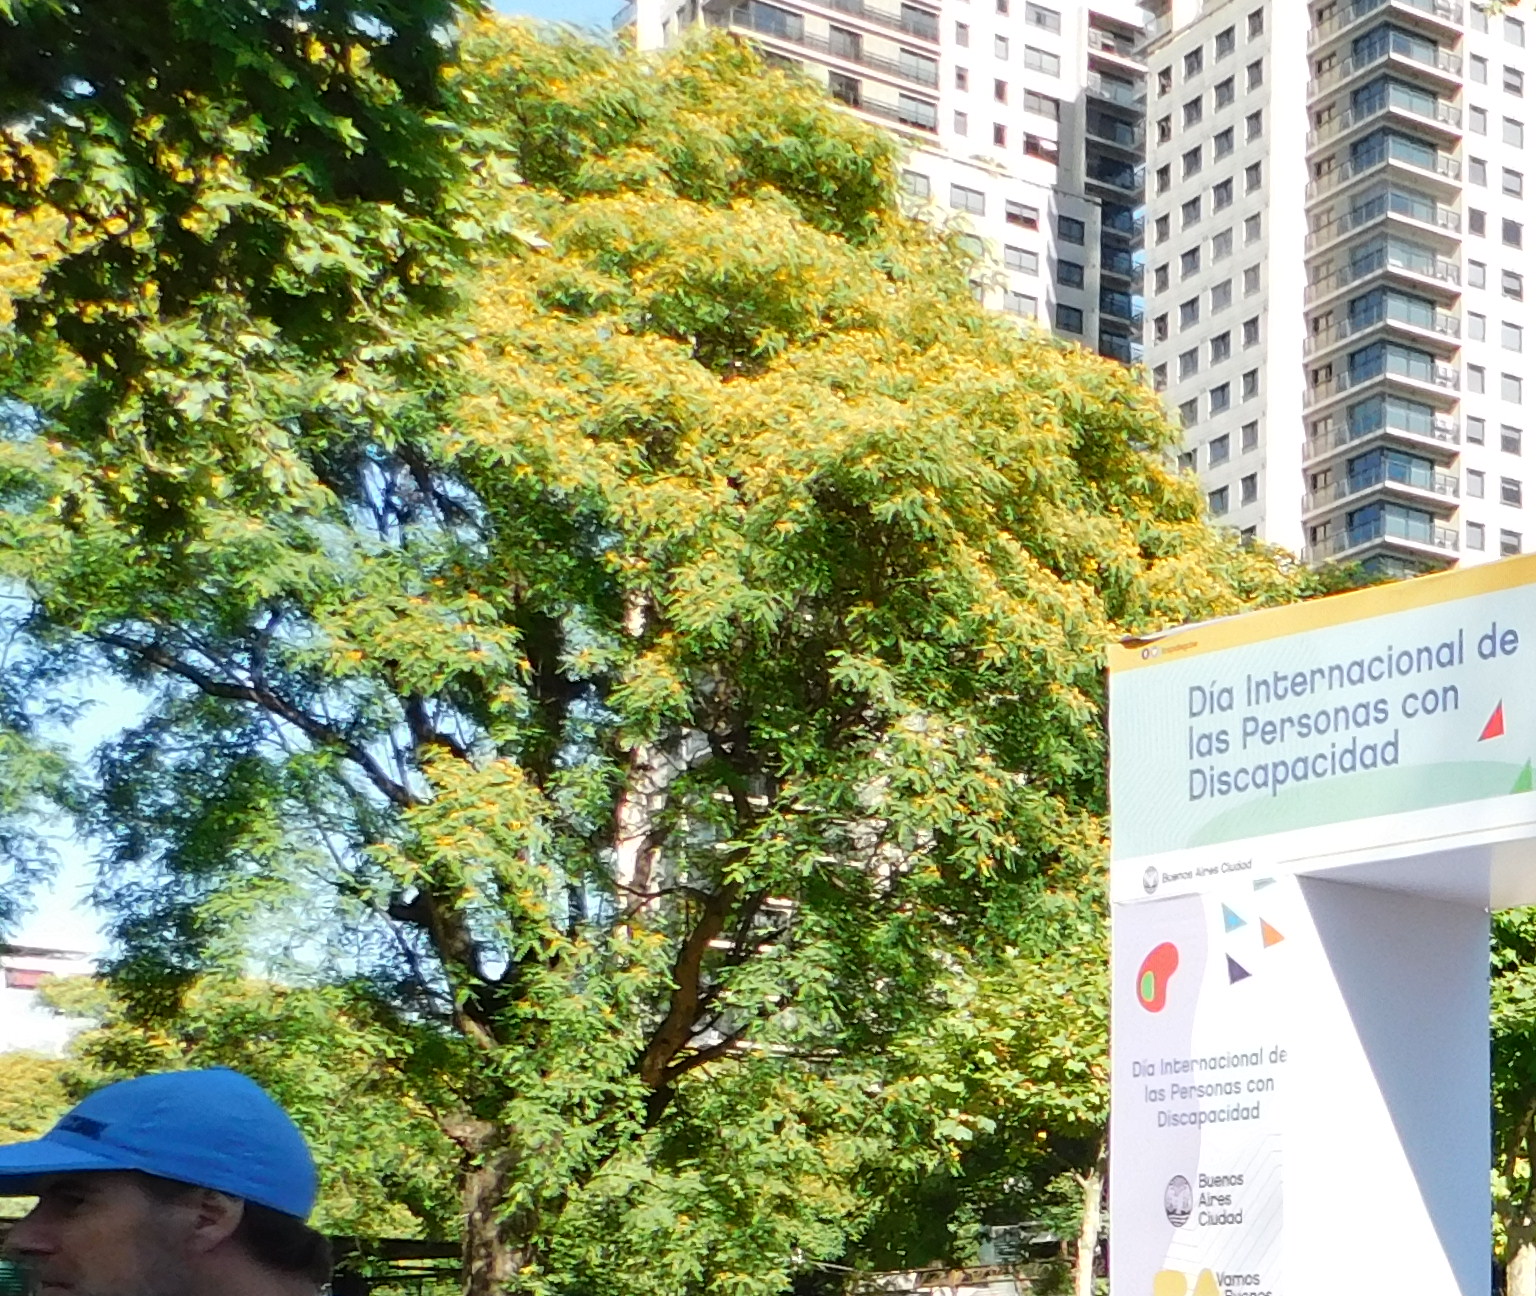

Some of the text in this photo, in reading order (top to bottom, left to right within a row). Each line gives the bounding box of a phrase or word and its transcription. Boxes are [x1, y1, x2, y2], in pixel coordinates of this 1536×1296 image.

[1189, 622, 1520, 719] Día Internacional de
[1189, 683, 1459, 760] las Personas con
[1189, 729, 1399, 802] Discapacidad
[1132, 1046, 1288, 1079] Día Internacional de
[1144, 1076, 1275, 1104] las Personas con
[1157, 1100, 1261, 1130] Discapacidad
[1198, 1173, 1245, 1189] Buenos
[1198, 1190, 1233, 1207] Aires
[1198, 1208, 1244, 1227] Ciudad
[1216, 1271, 1261, 1288] Vamos
